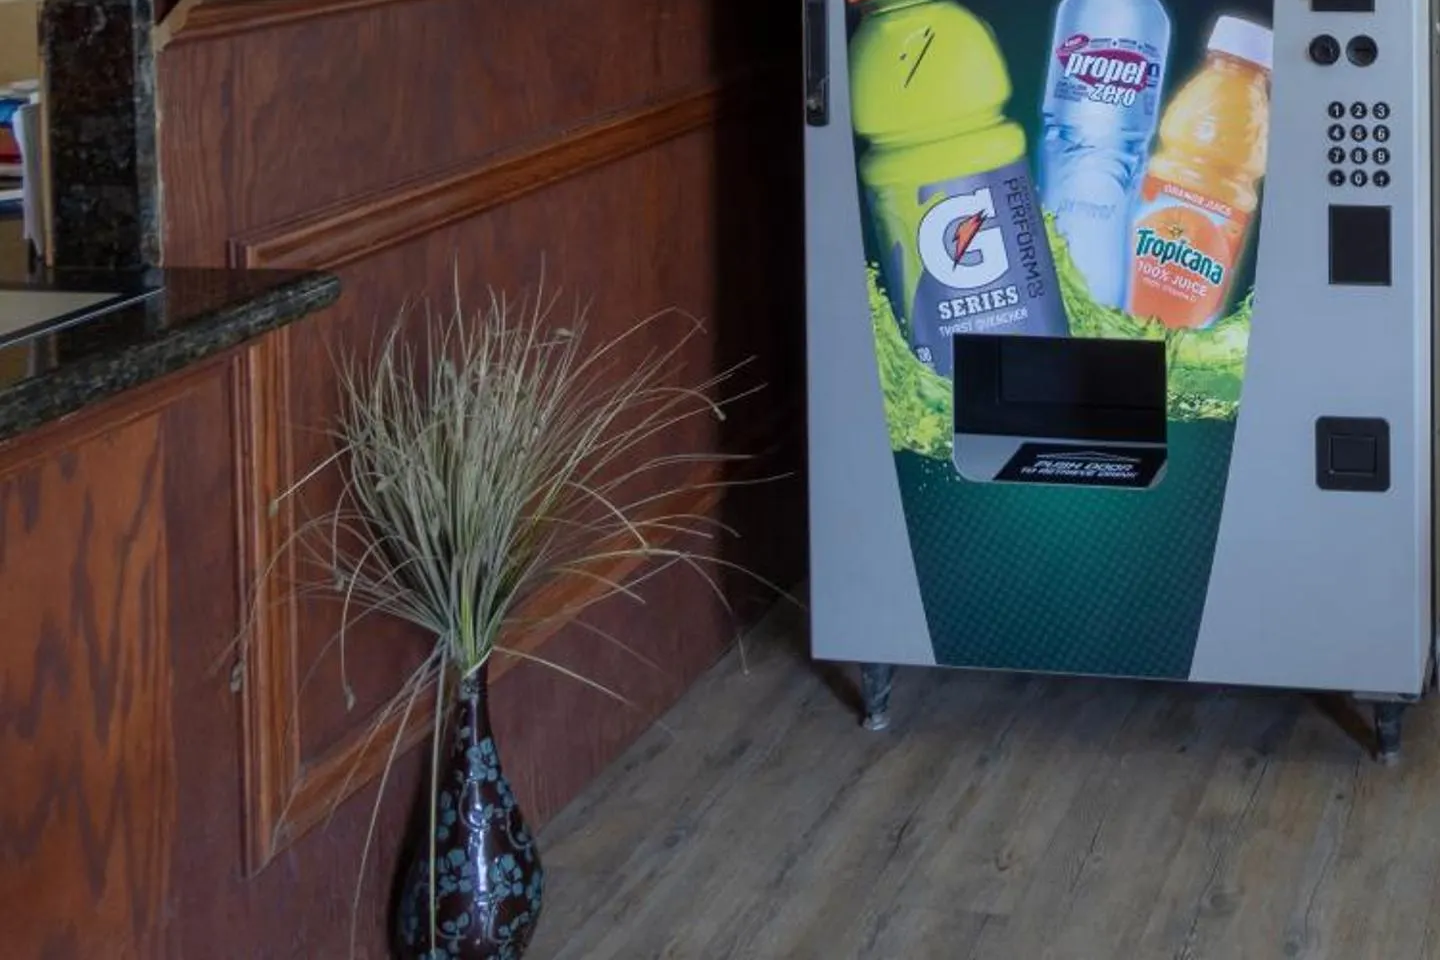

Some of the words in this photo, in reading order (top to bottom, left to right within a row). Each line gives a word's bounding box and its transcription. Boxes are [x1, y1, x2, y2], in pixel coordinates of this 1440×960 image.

[1064, 52, 1147, 85] propel
[1087, 83, 1137, 108] zero
[1333, 104, 1339, 116] 1
[1354, 105, 1363, 116] 2
[1377, 105, 1385, 117] 3
[1331, 127, 1341, 139] 4
[1377, 128, 1385, 140] 6
[1333, 150, 1341, 162] 7
[1354, 151, 1363, 162] 8
[1377, 151, 1385, 162] 9
[1354, 173, 1362, 185] 0
[918, 187, 1009, 289] G
[1136, 227, 1224, 285] Tropicana
[1138, 260, 1171, 281] 100%
[1171, 275, 1207, 296] JUICE
[938, 285, 1020, 321] SERIES
[1034, 460, 1083, 470] PUSH
